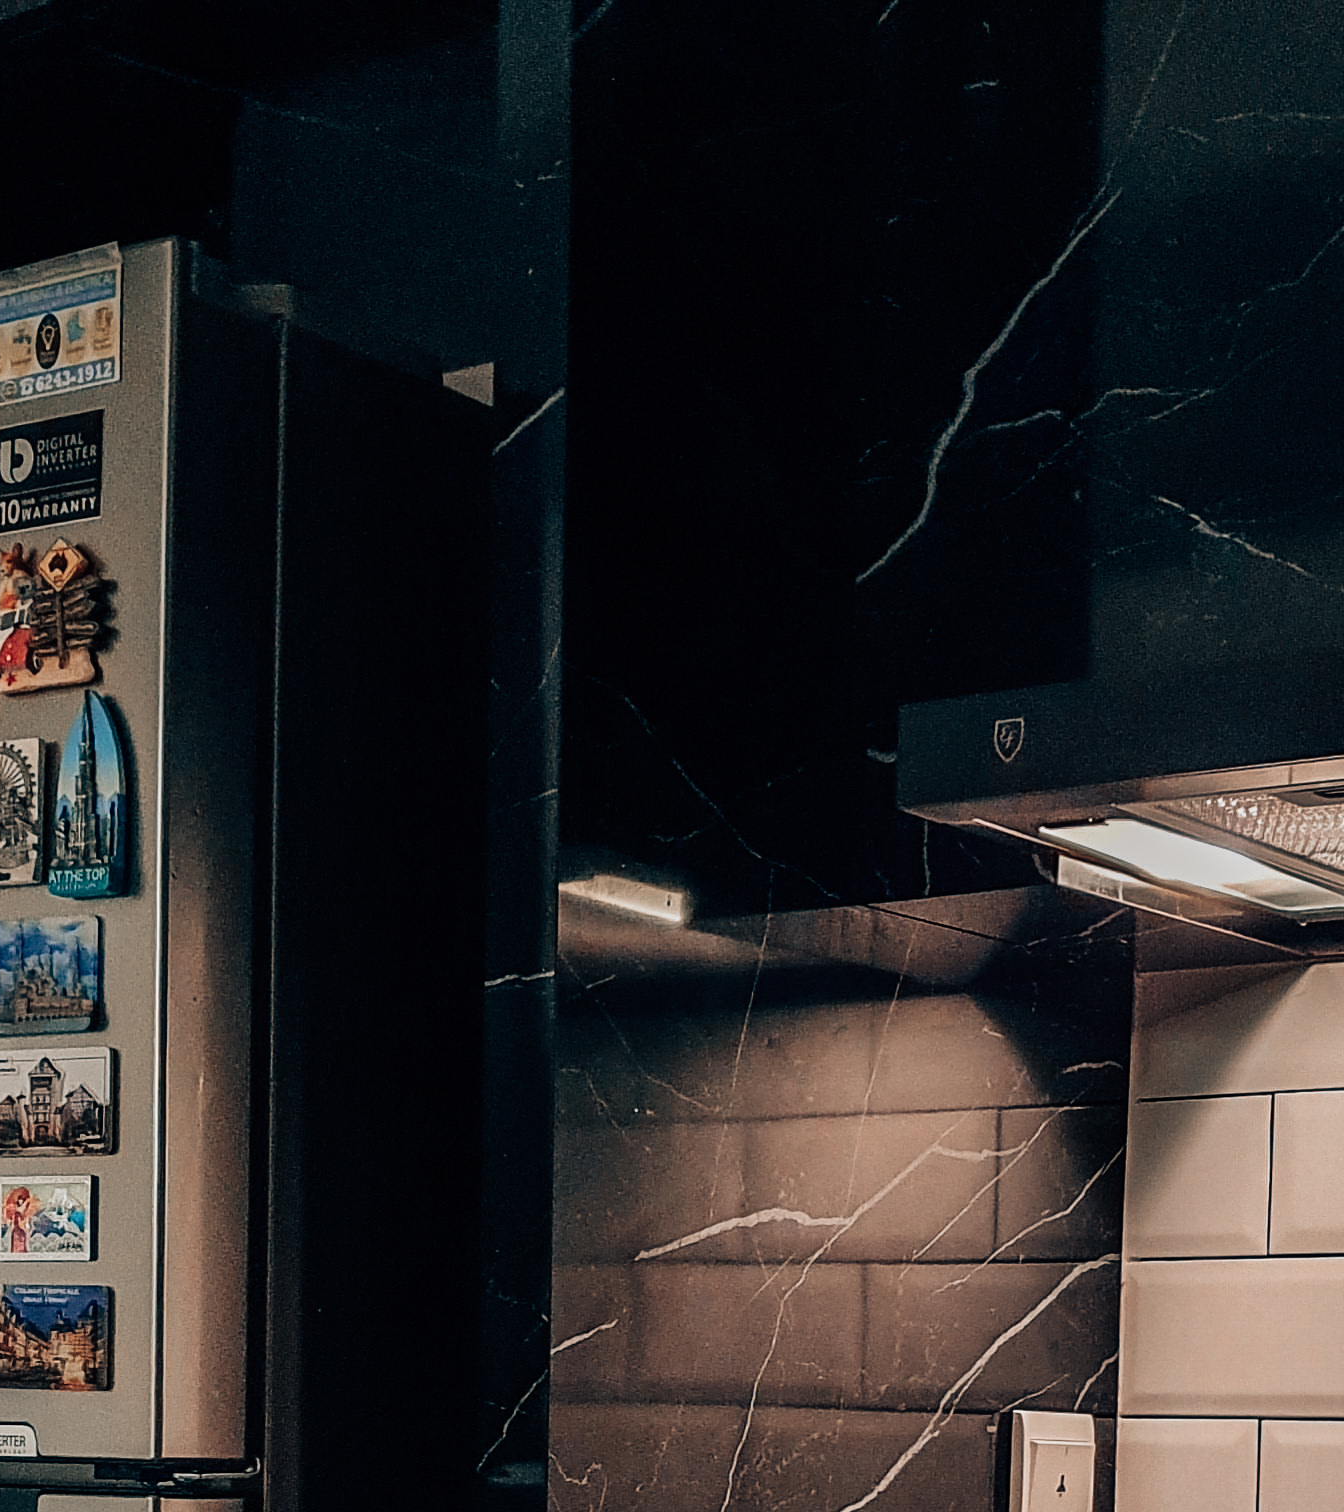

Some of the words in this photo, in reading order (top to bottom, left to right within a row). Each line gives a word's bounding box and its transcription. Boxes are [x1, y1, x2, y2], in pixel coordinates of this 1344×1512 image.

[36, 361, 112, 392] 6243-1912
[36, 433, 84, 453] DIGITAL
[36, 444, 97, 467] INVERTER
[0, 498, 21, 526] 10
[21, 496, 97, 522] WARRANTY
[48, 869, 62, 883] AT
[64, 868, 84, 882] THE
[84, 867, 105, 881] TOP
